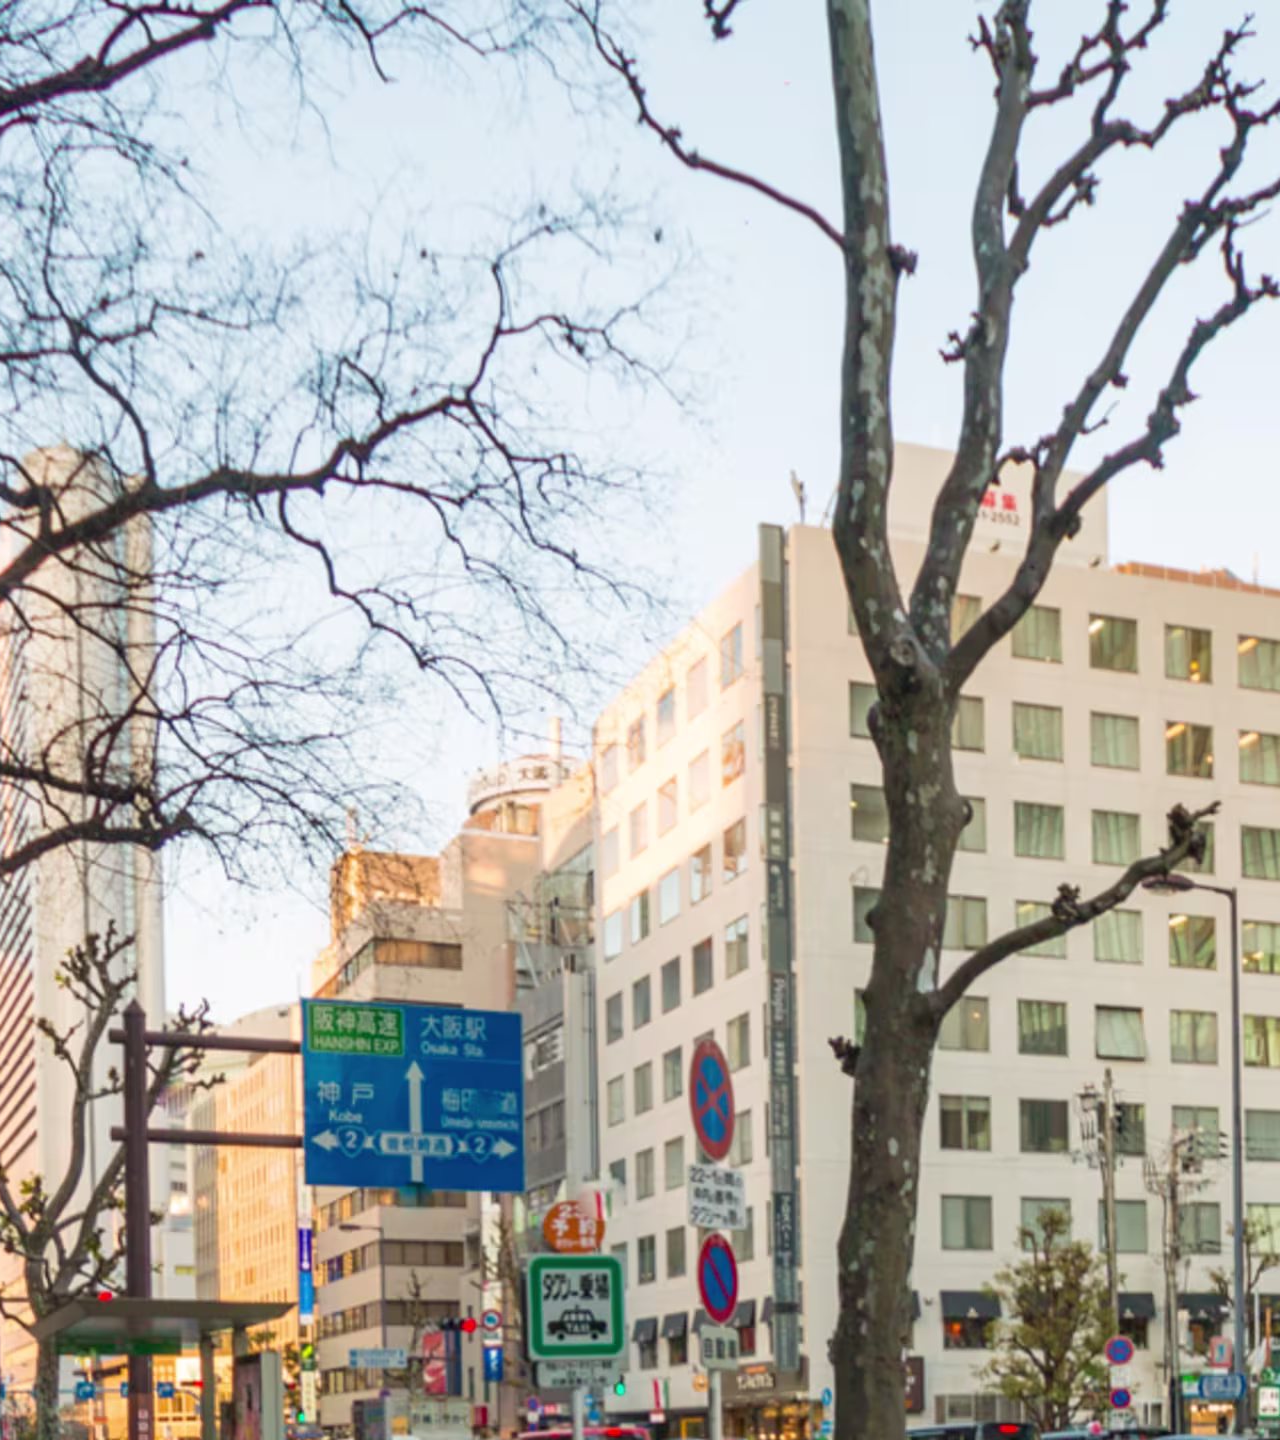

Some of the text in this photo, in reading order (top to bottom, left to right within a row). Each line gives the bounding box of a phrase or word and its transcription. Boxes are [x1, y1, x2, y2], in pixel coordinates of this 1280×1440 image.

[313, 1006, 399, 1036] 阪神高速
[421, 1015, 487, 1041] 大阪駅
[314, 1037, 370, 1051] HANSHIN
[422, 1041, 458, 1057] Osaka
[317, 1080, 375, 1106] 神戸
[329, 1109, 363, 1124] Kobe
[345, 1131, 358, 1149] 2
[475, 1137, 486, 1154] 2
